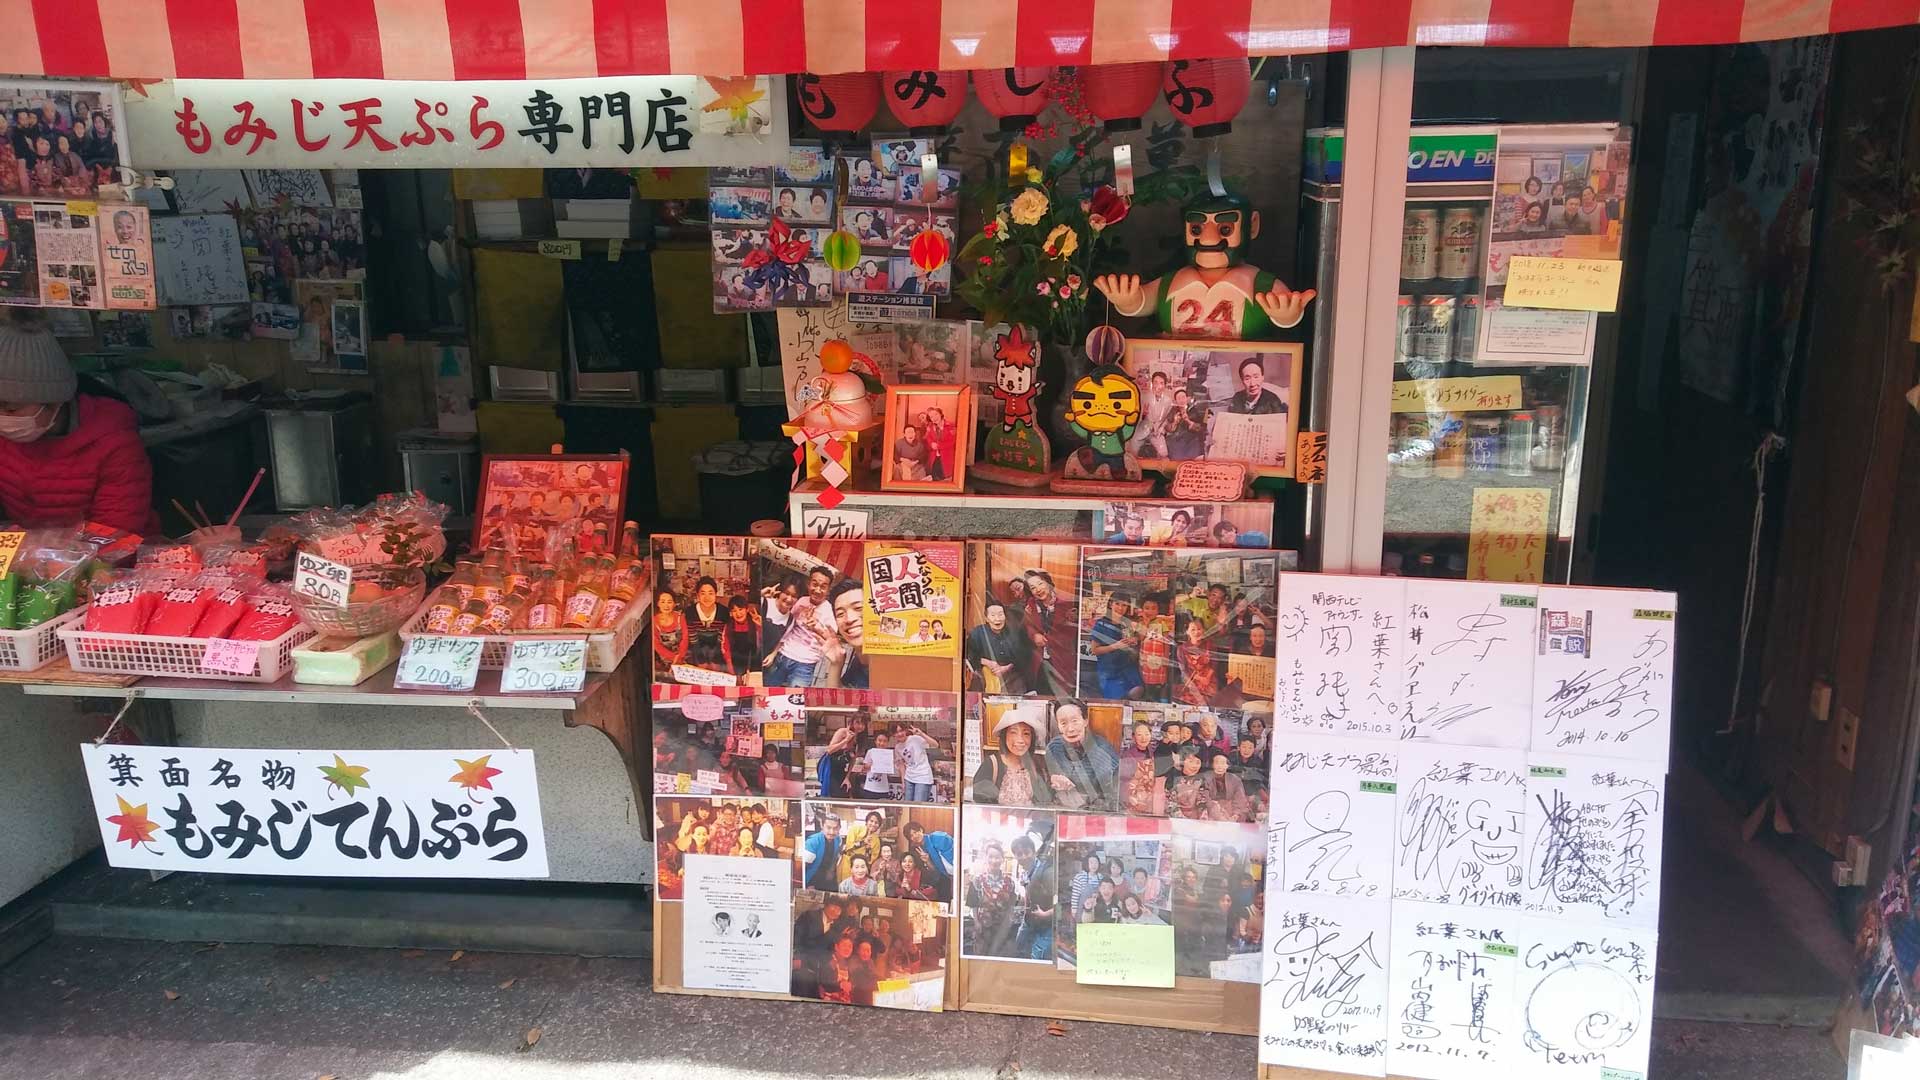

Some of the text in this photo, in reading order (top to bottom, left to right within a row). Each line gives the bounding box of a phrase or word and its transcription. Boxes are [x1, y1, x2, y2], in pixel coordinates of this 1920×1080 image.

[174, 88, 694, 156] もみじ天ぷら専門店
[1408, 151, 1428, 169] O
[1429, 149, 1466, 168] EN
[1176, 299, 1235, 333] 24
[1347, 721, 1391, 733] 2015.10.3
[107, 753, 297, 791] 箕面名物
[164, 792, 528, 862] もみじてんぷら
